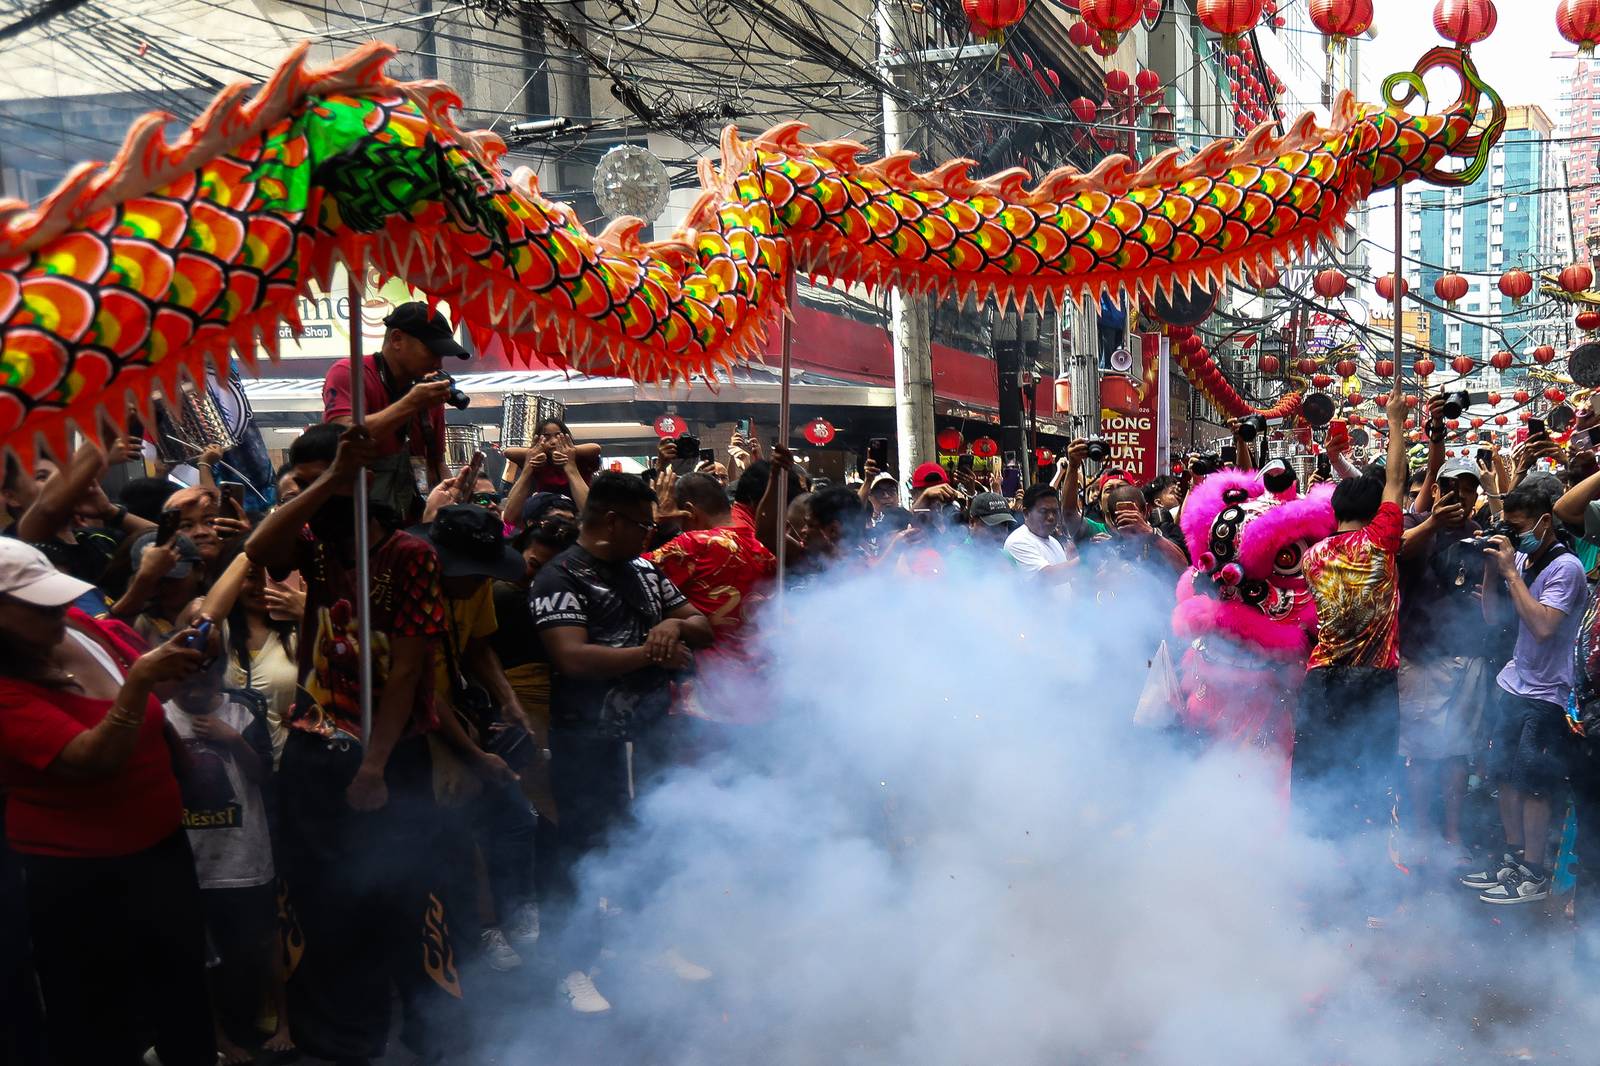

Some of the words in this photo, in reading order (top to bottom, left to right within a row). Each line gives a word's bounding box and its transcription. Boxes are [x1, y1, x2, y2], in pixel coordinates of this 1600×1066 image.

[298, 296, 350, 321] ine
[305, 327, 328, 338] Shop
[1105, 446, 1146, 459] UAT
[1102, 460, 1143, 474] HAI
